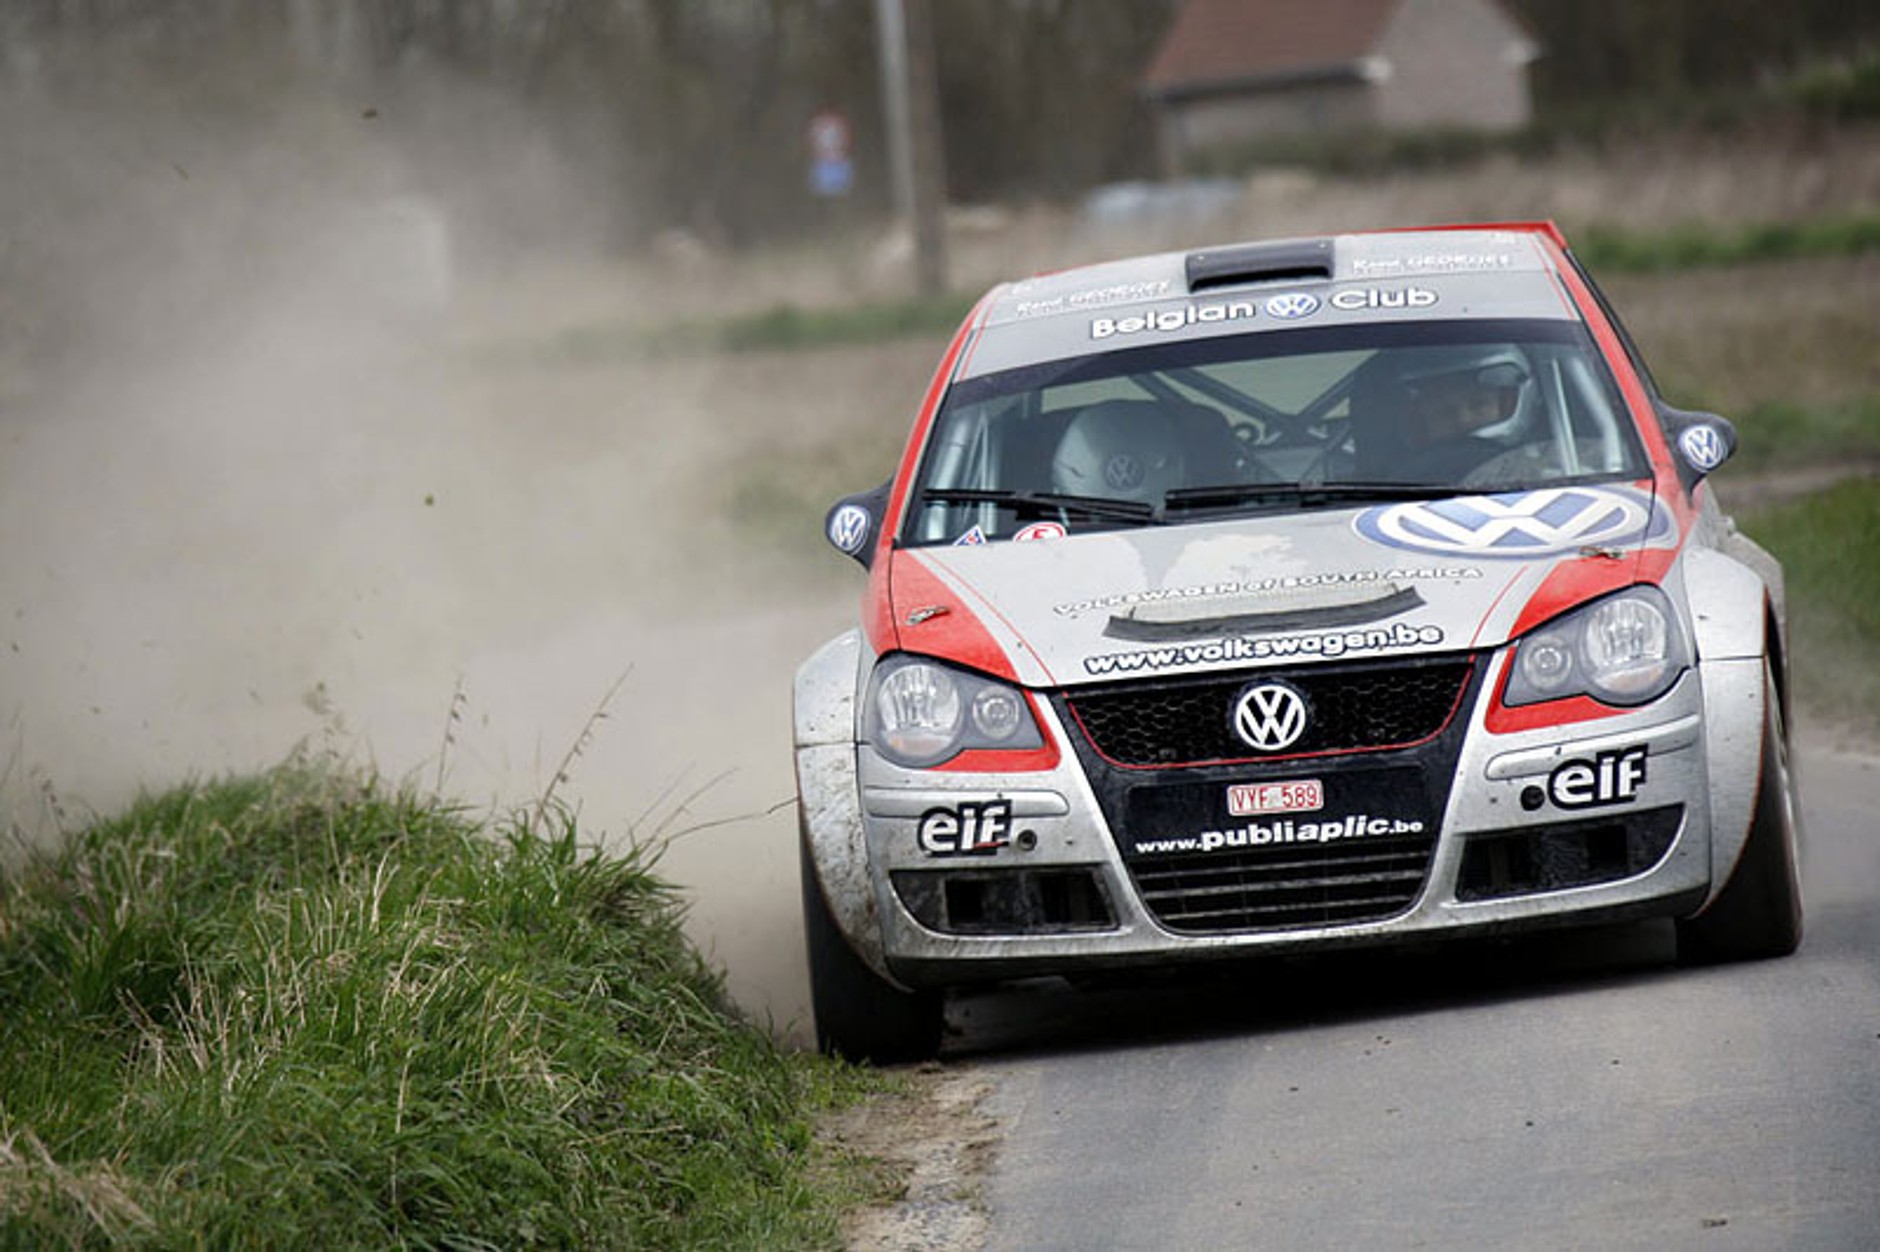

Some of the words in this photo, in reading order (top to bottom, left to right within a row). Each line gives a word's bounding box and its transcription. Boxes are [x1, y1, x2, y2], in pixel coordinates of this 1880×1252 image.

[1091, 301, 1254, 339] Belgian
[1331, 288, 1438, 310] Club
[1053, 583, 1239, 615] VOLKSWAGEN
[1244, 577, 1276, 591] of
[1280, 571, 1378, 588] SOUTH
[1385, 567, 1483, 582] AFRICA
[1083, 624, 1444, 675] www.volkswagen.be
[1281, 785, 1320, 808] 589
[1135, 815, 1424, 854] www.publiaplic.be
